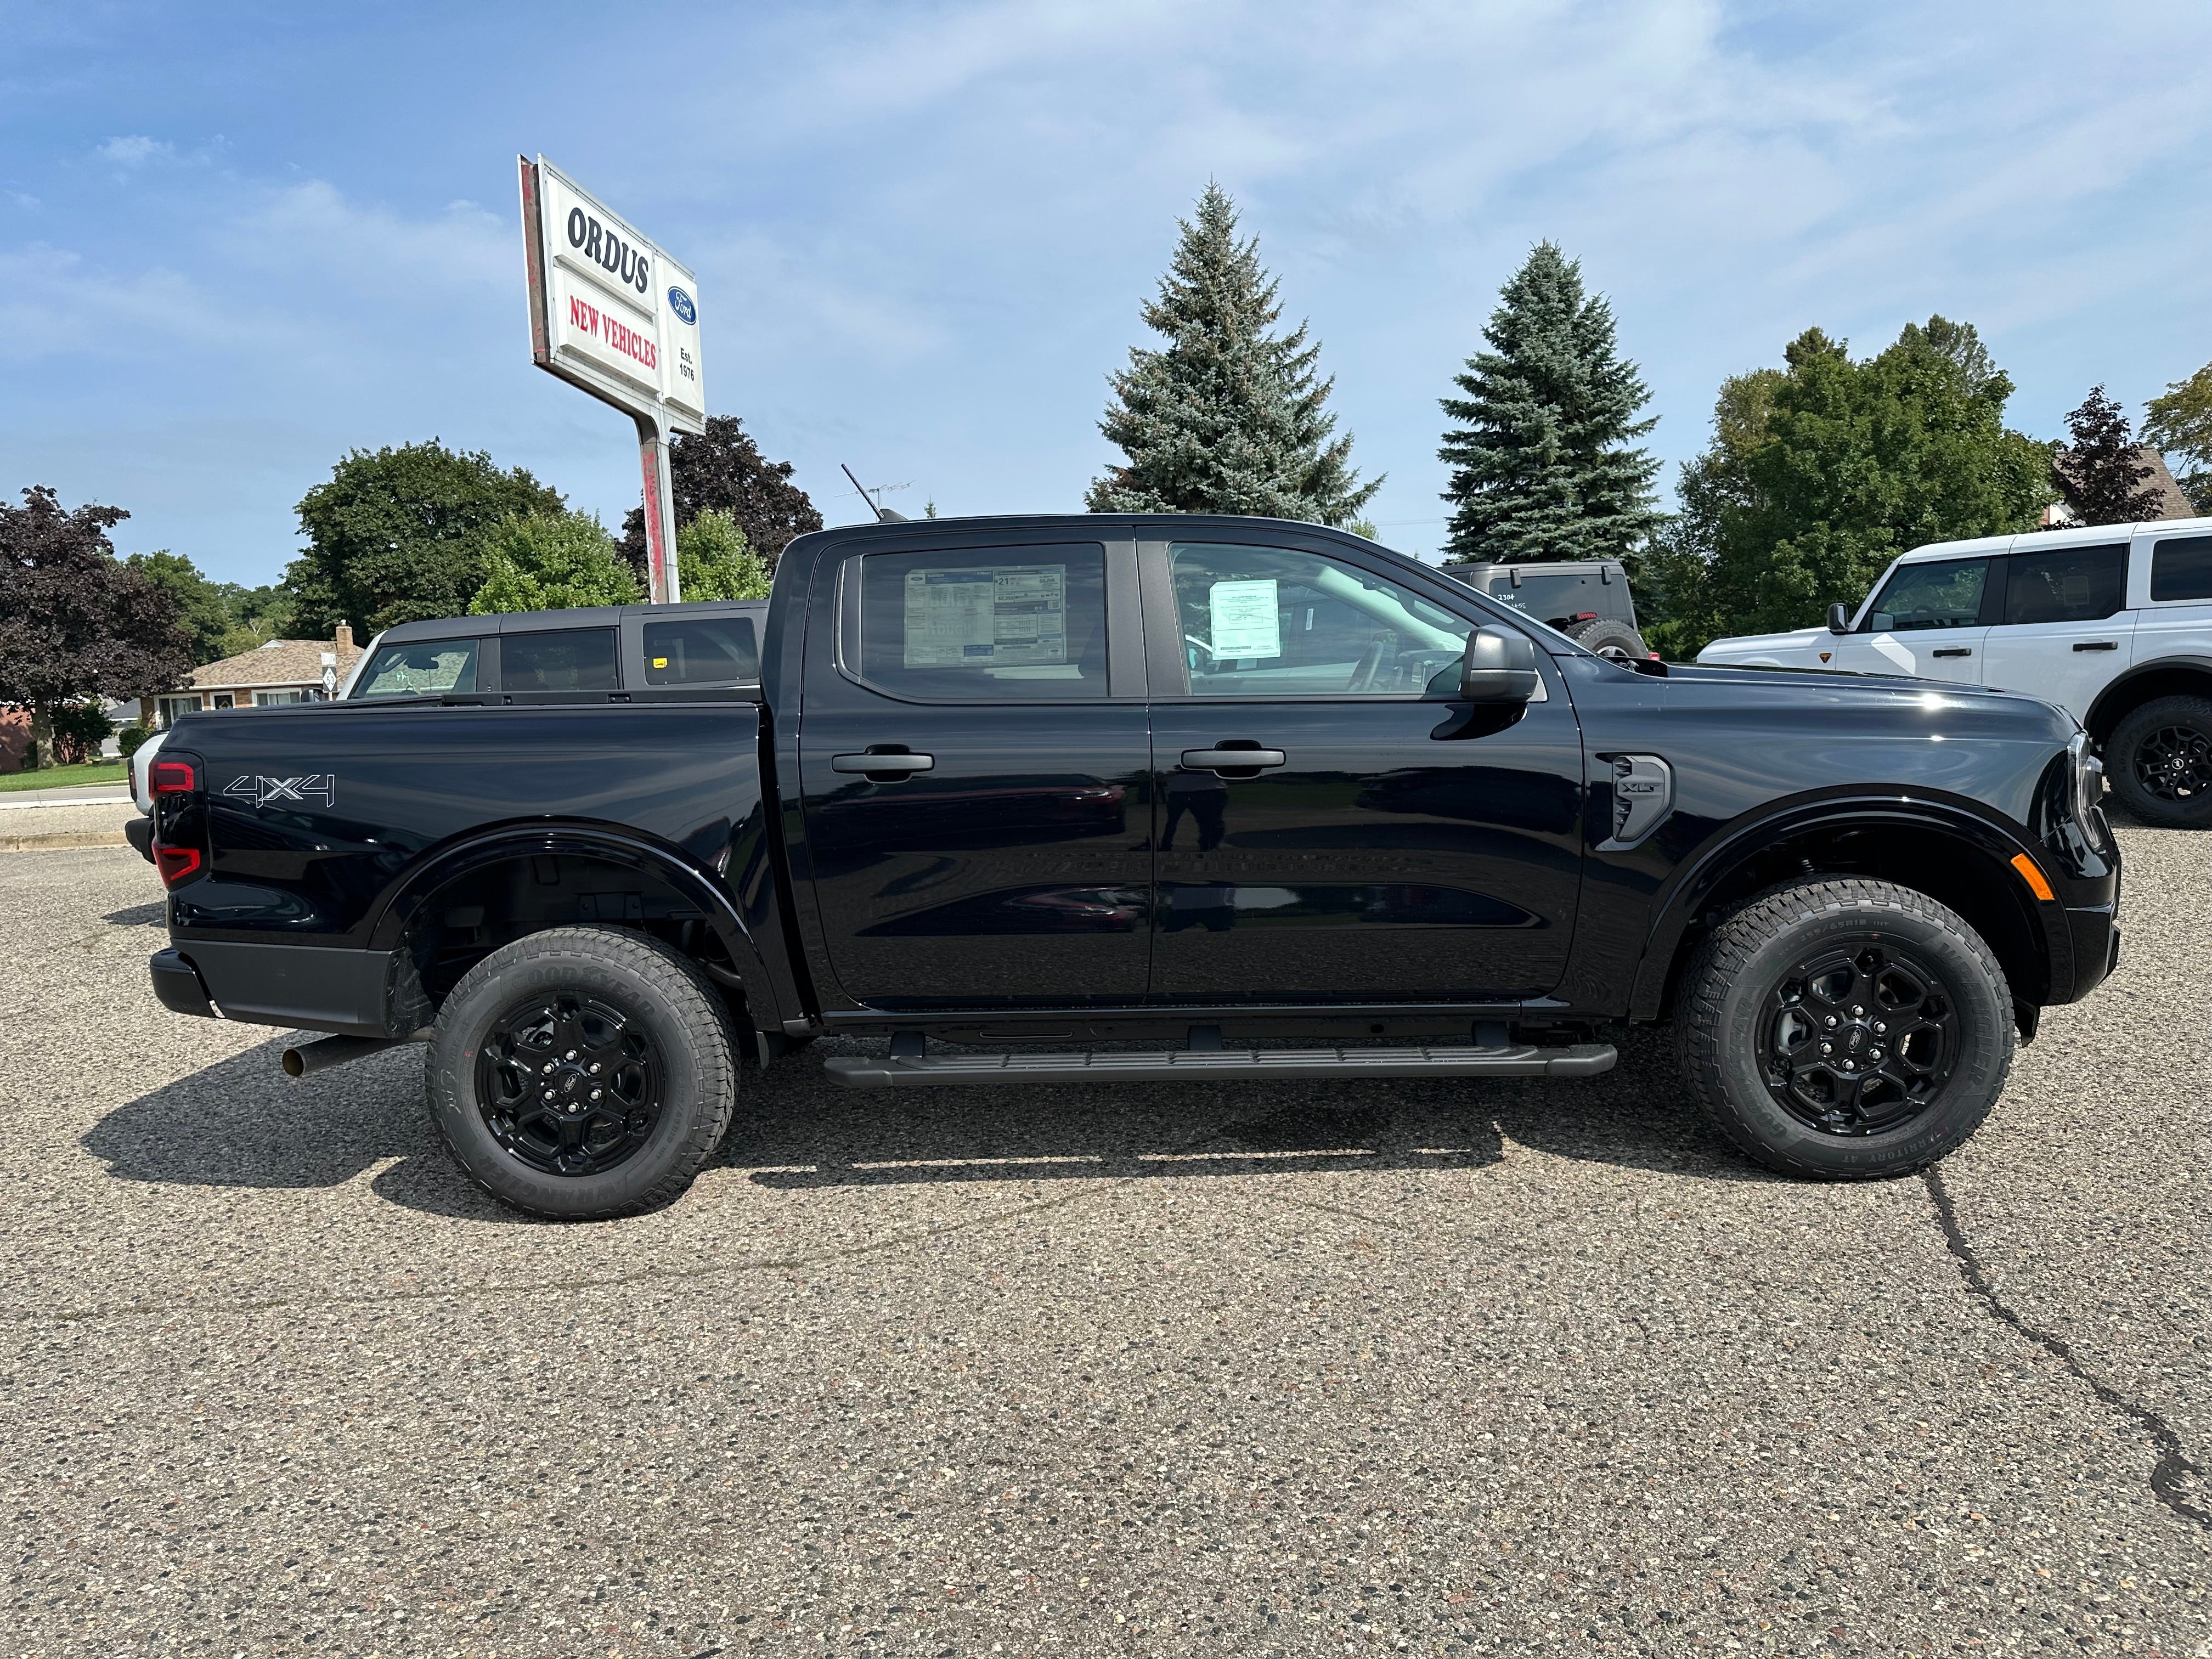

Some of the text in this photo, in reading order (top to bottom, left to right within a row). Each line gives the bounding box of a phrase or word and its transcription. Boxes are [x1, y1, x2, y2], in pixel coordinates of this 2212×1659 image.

[567, 207, 649, 294] ORDUS
[674, 291, 692, 319] Ford
[570, 295, 656, 370] NEW VEHICLES
[680, 347, 692, 365] Est.
[680, 363, 695, 382] 1976
[322, 654, 335, 663] SOUTH
[326, 676, 335, 685] 53
[1621, 782, 1661, 793] XLT
[1799, 919, 1867, 942] 255/65R18
[511, 966, 655, 1015] GOODYEAR
[1935, 941, 1994, 1086] WRANGLER
[1726, 995, 1787, 1139] GOODYEAR
[1842, 1154, 1859, 1164] AT
[1869, 1133, 1939, 1163] ERRITORY
[478, 1155, 624, 1203] WRANGLER
